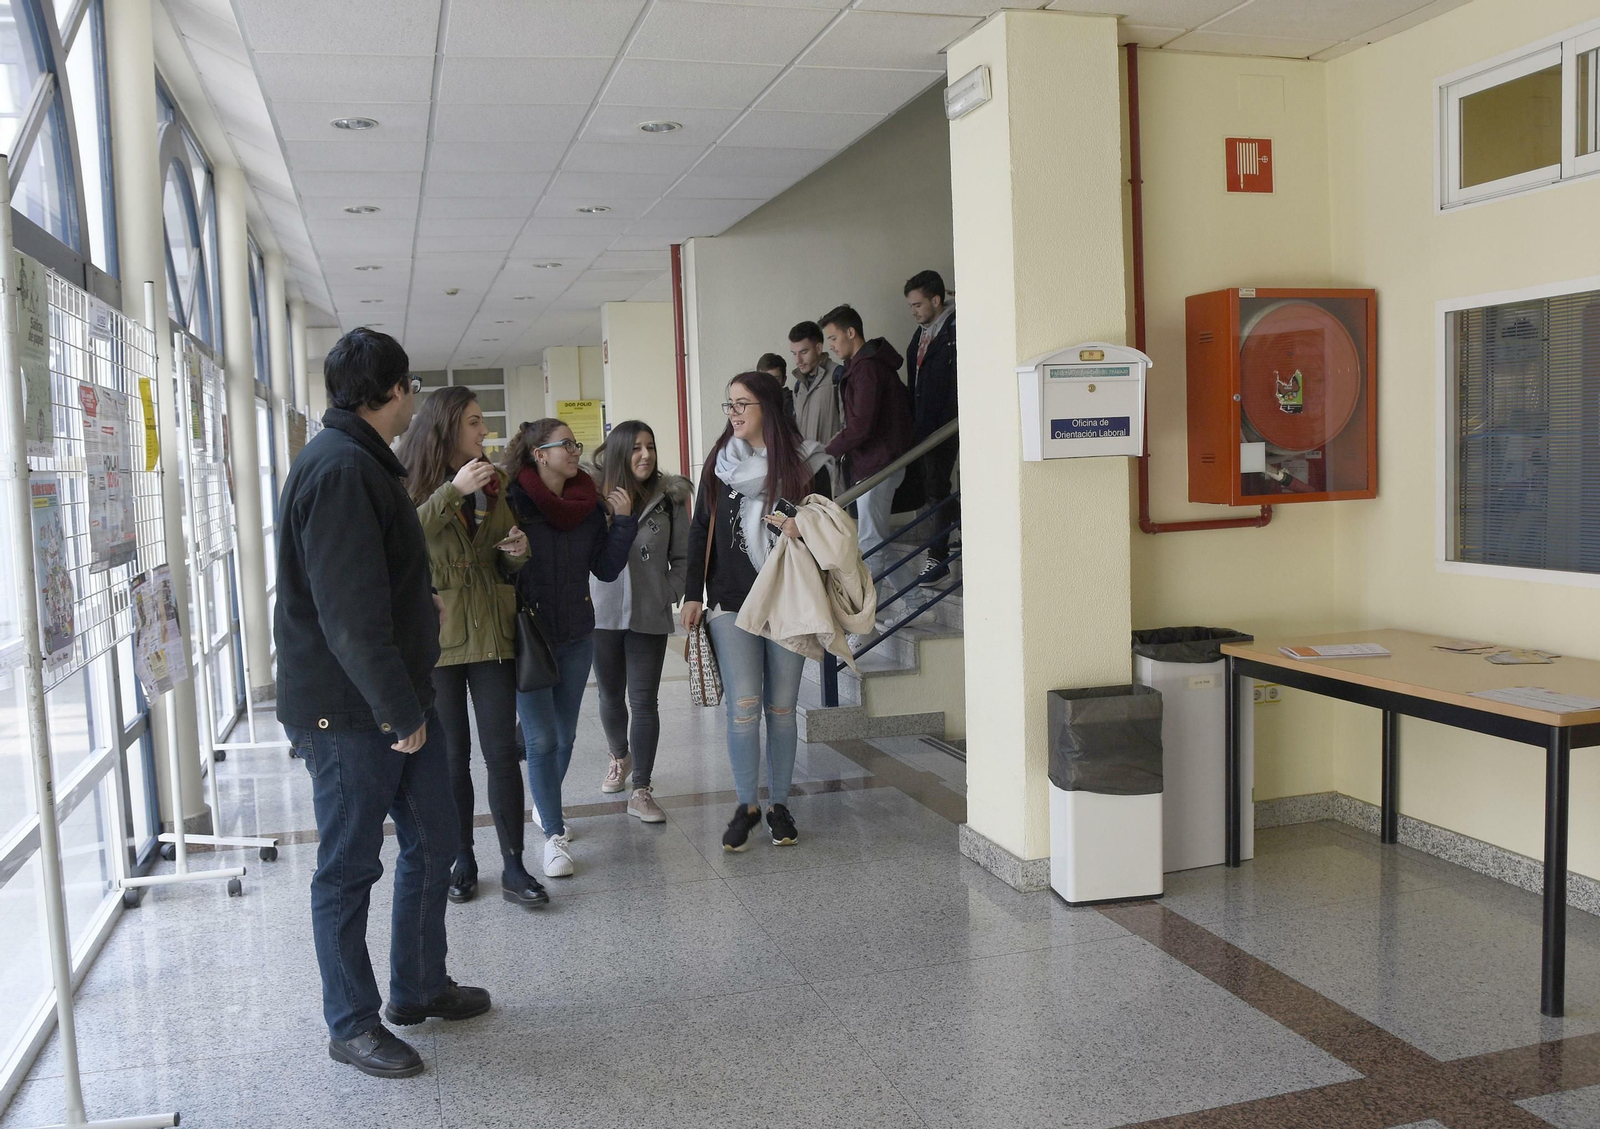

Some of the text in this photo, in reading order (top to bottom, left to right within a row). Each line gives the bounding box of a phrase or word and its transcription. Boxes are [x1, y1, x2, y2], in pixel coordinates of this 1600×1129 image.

[1072, 418, 1109, 427] Oficina de
[1055, 428, 1126, 439] Orientación Laboral
